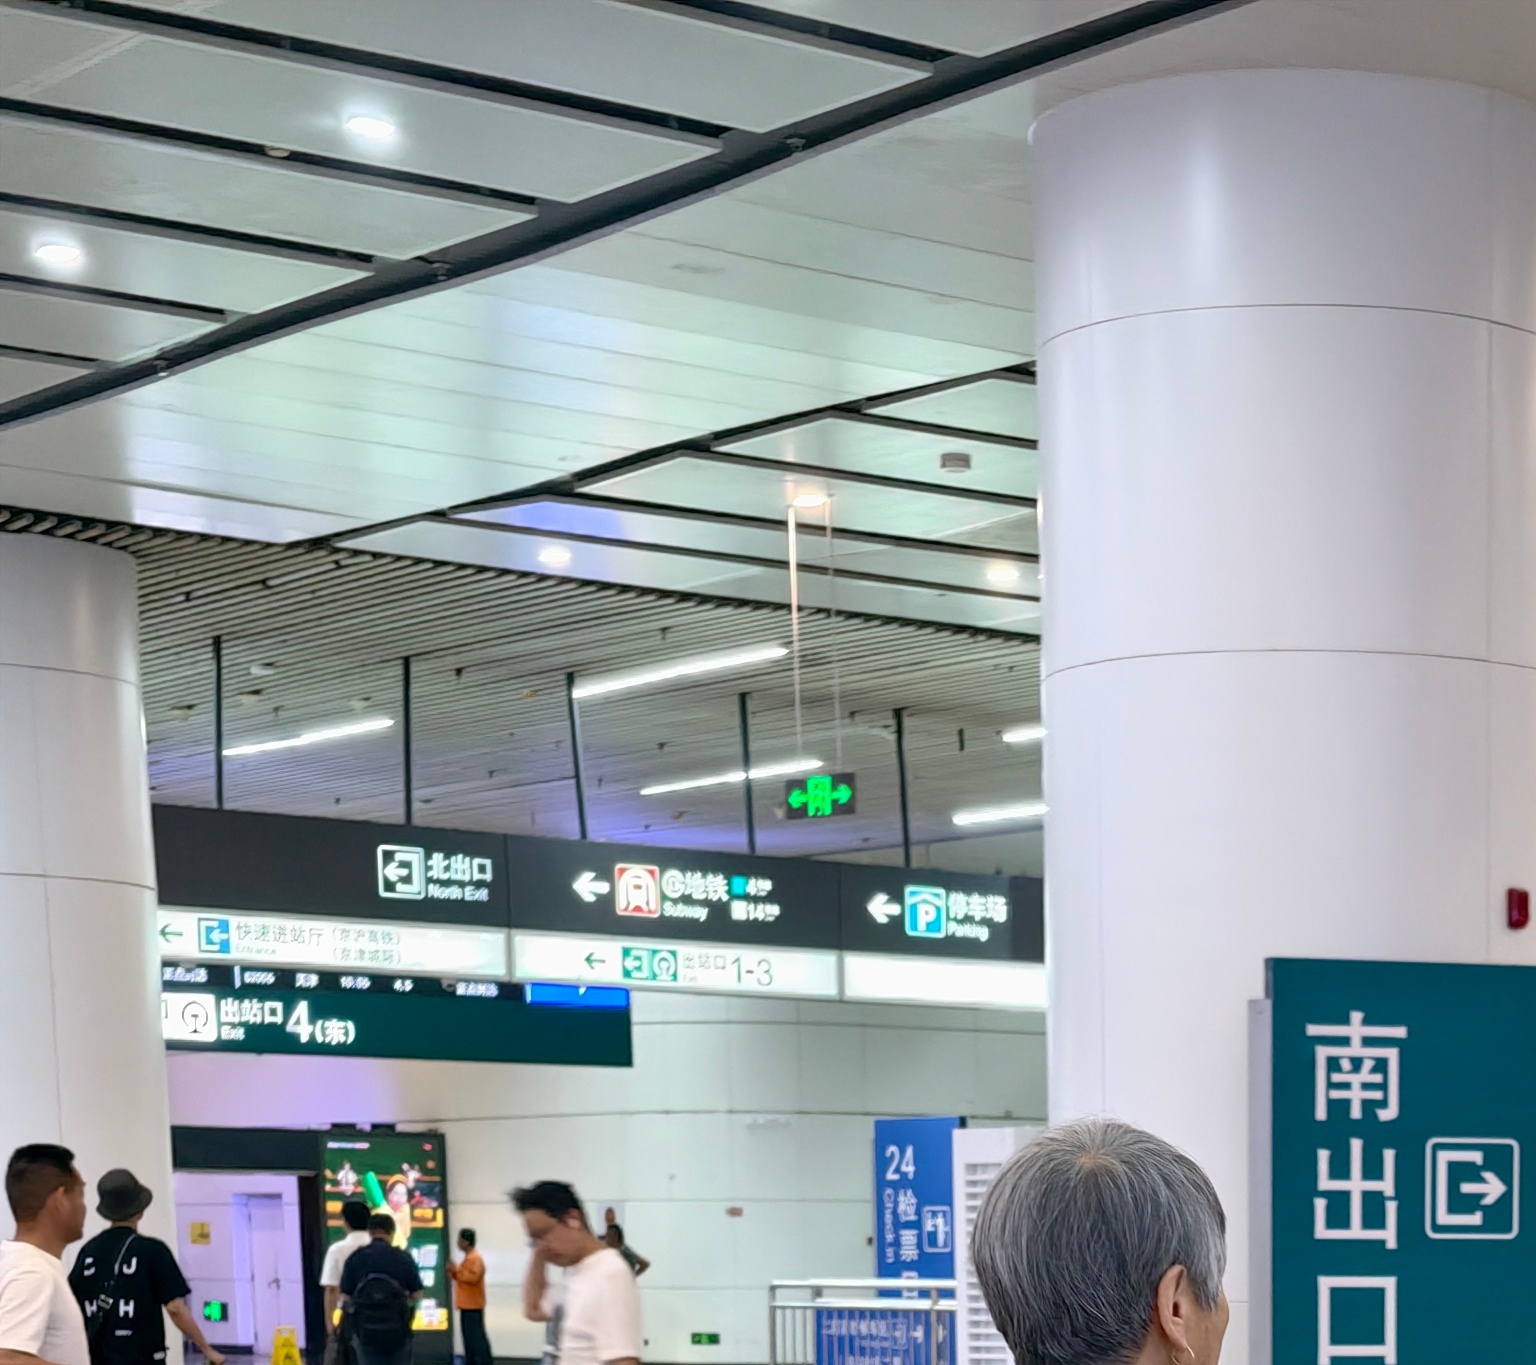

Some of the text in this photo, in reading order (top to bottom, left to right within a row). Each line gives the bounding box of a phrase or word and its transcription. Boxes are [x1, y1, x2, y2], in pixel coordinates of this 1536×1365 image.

[427, 853, 492, 882] 北出口
[427, 883, 463, 900] North
[684, 871, 729, 901] 地铁
[662, 901, 708, 922] Subway
[731, 956, 773, 986] 1-3
[220, 997, 284, 1025] 出站口
[285, 1000, 315, 1044] 4
[885, 1144, 916, 1181] 24
[122, 1256, 137, 1275] J
[119, 1299, 134, 1318] H
